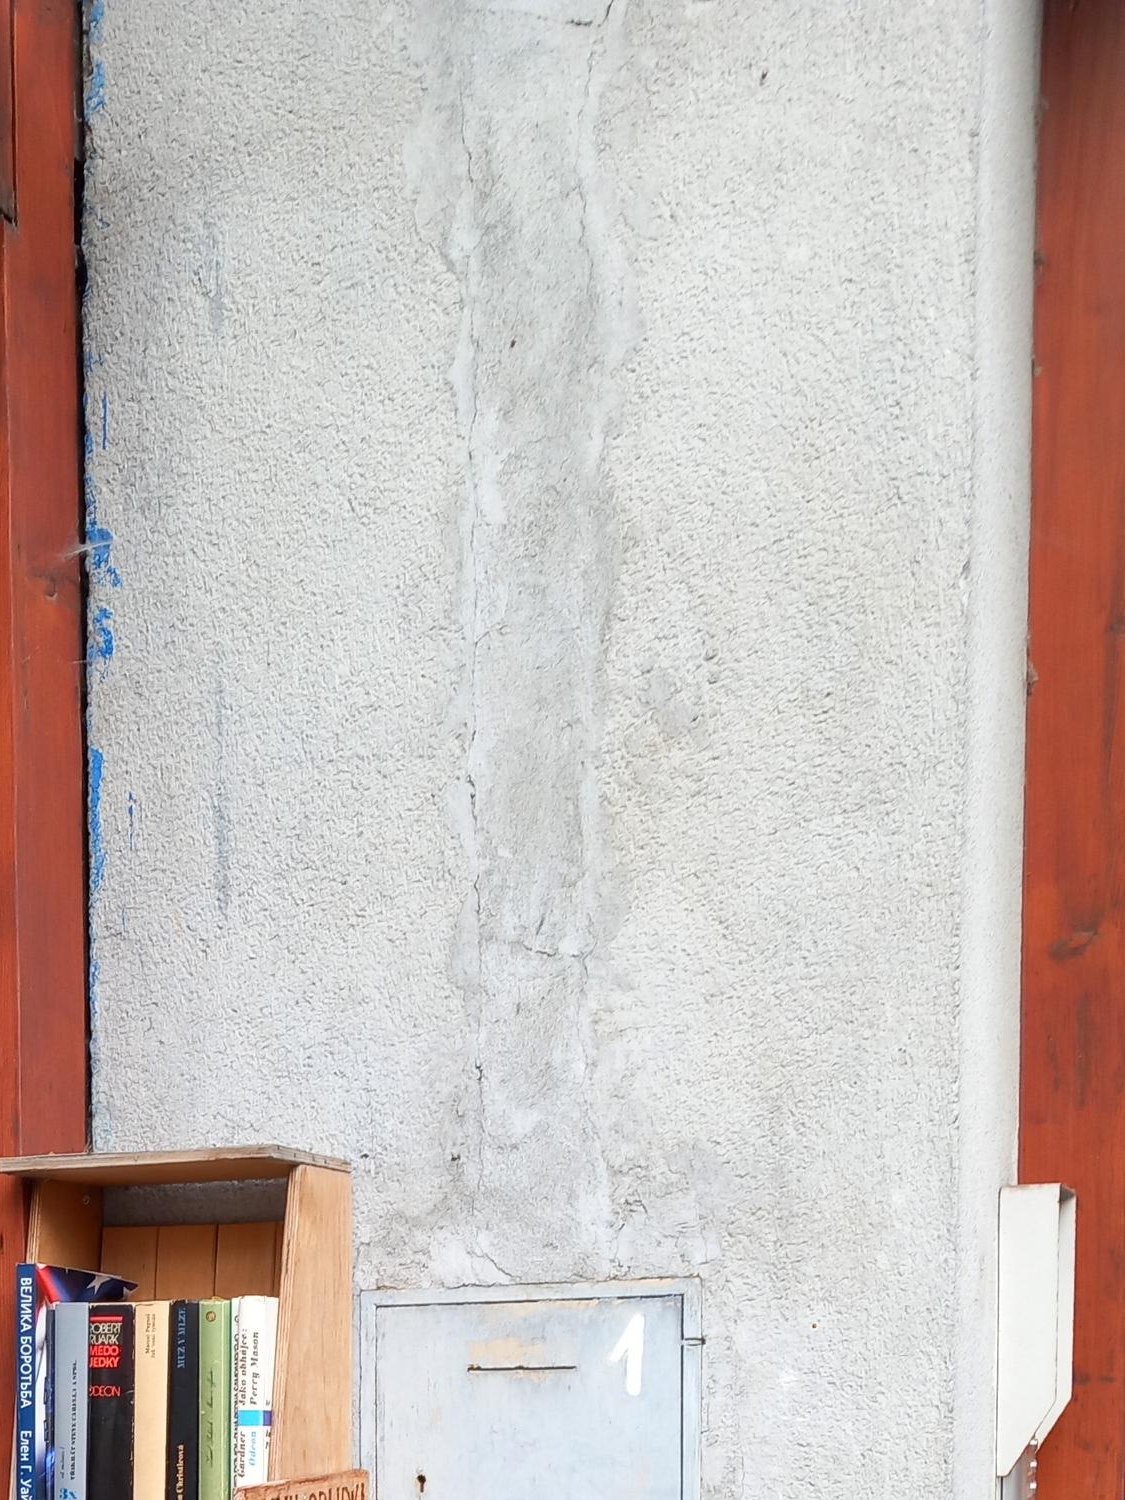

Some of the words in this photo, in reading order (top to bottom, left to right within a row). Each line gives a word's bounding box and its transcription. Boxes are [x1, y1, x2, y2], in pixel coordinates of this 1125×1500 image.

[19, 1277, 32, 1333] ВЕЛИКА
[89, 1334, 120, 1345] RUARK
[250, 1330, 260, 1368] Mason
[607, 1313, 646, 1396] 1
[19, 1335, 32, 1409] БОРОТЬБА
[249, 1372, 261, 1406] Perry
[239, 1380, 247, 1406] Jako
[20, 1430, 33, 1461] Елен
[237, 1431, 246, 1478] Gardner
[247, 1431, 257, 1466] Odeon
